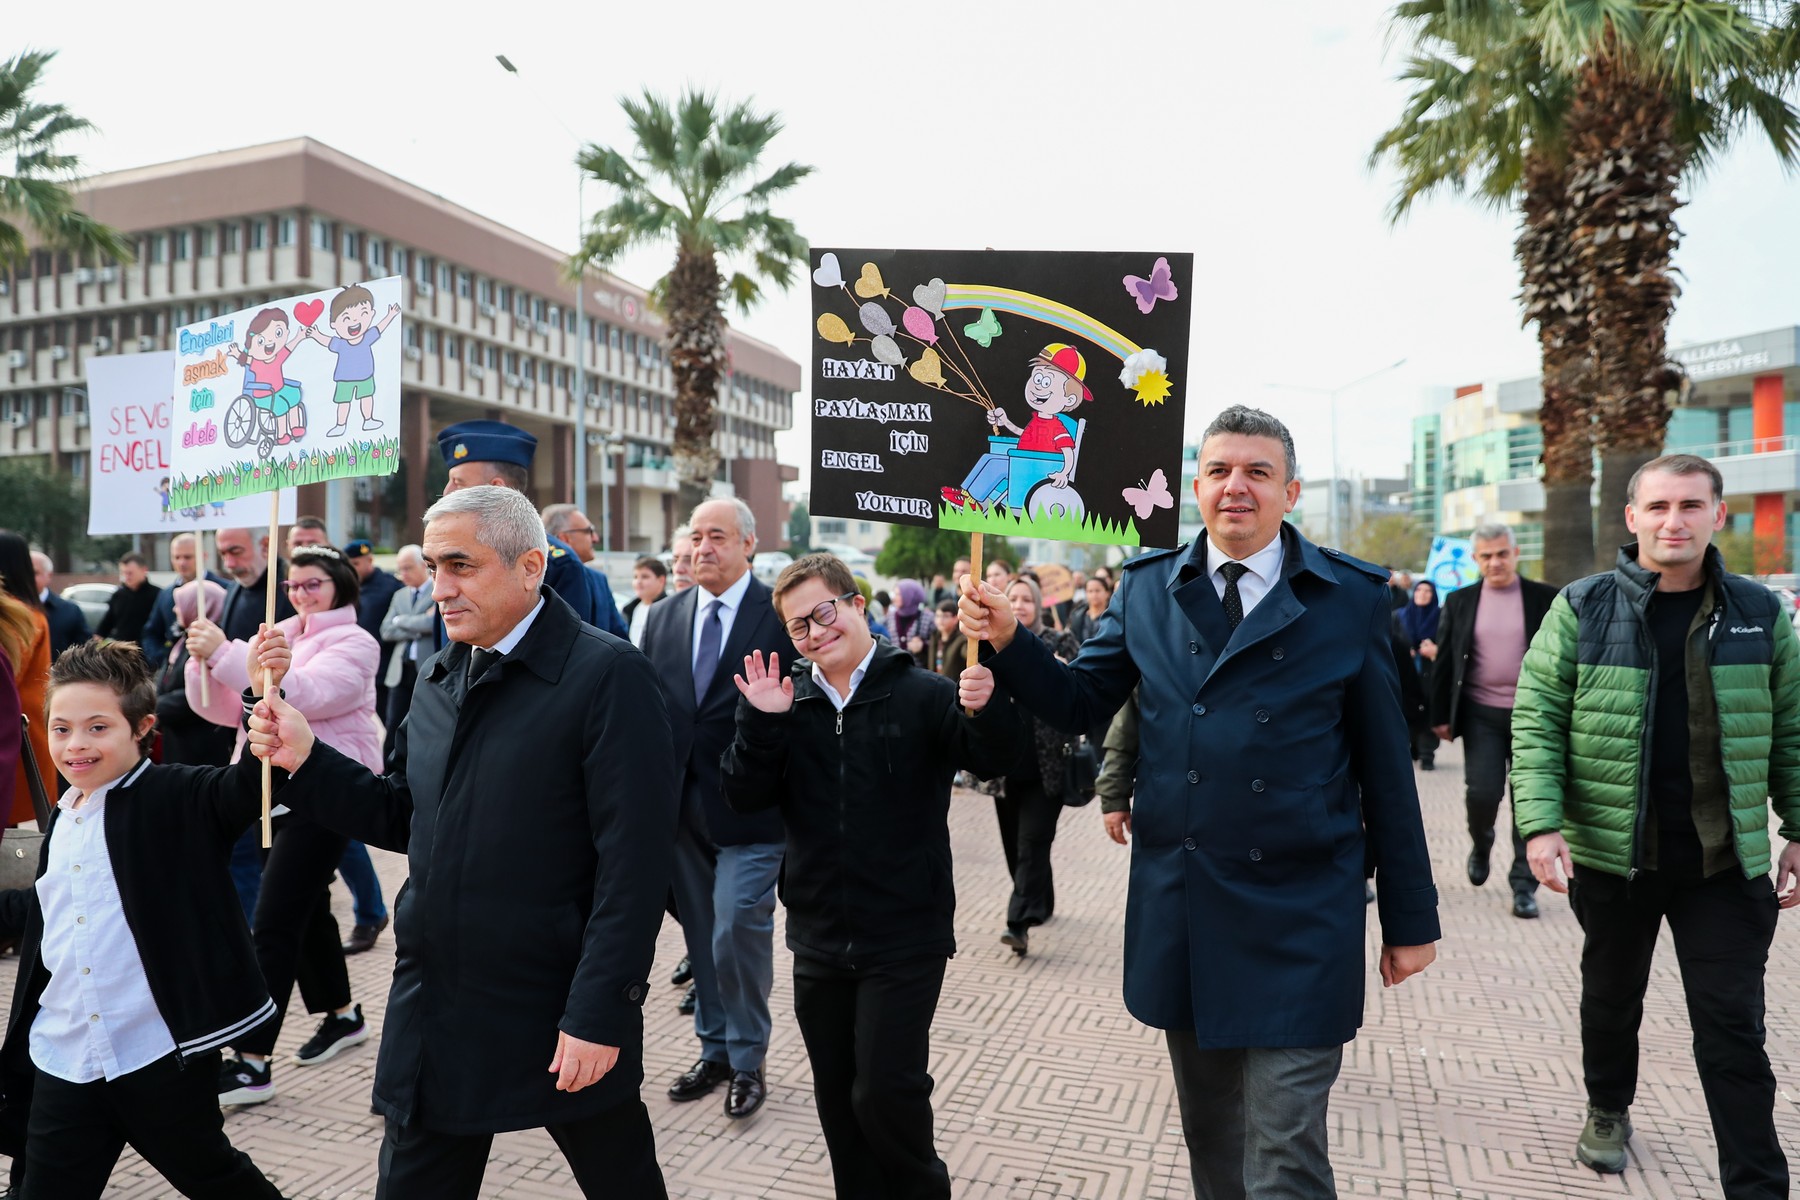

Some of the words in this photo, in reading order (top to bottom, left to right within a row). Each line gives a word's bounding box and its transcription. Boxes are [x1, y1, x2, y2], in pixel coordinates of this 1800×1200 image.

[180, 321, 233, 354] Engelleri
[184, 352, 227, 383] aşmak
[191, 390, 213, 411] için
[183, 422, 196, 446] el
[198, 420, 216, 444] ele
[890, 430, 928, 454] İÇİN
[823, 451, 883, 471] ENGEL
[857, 491, 930, 517] YOKTUR
